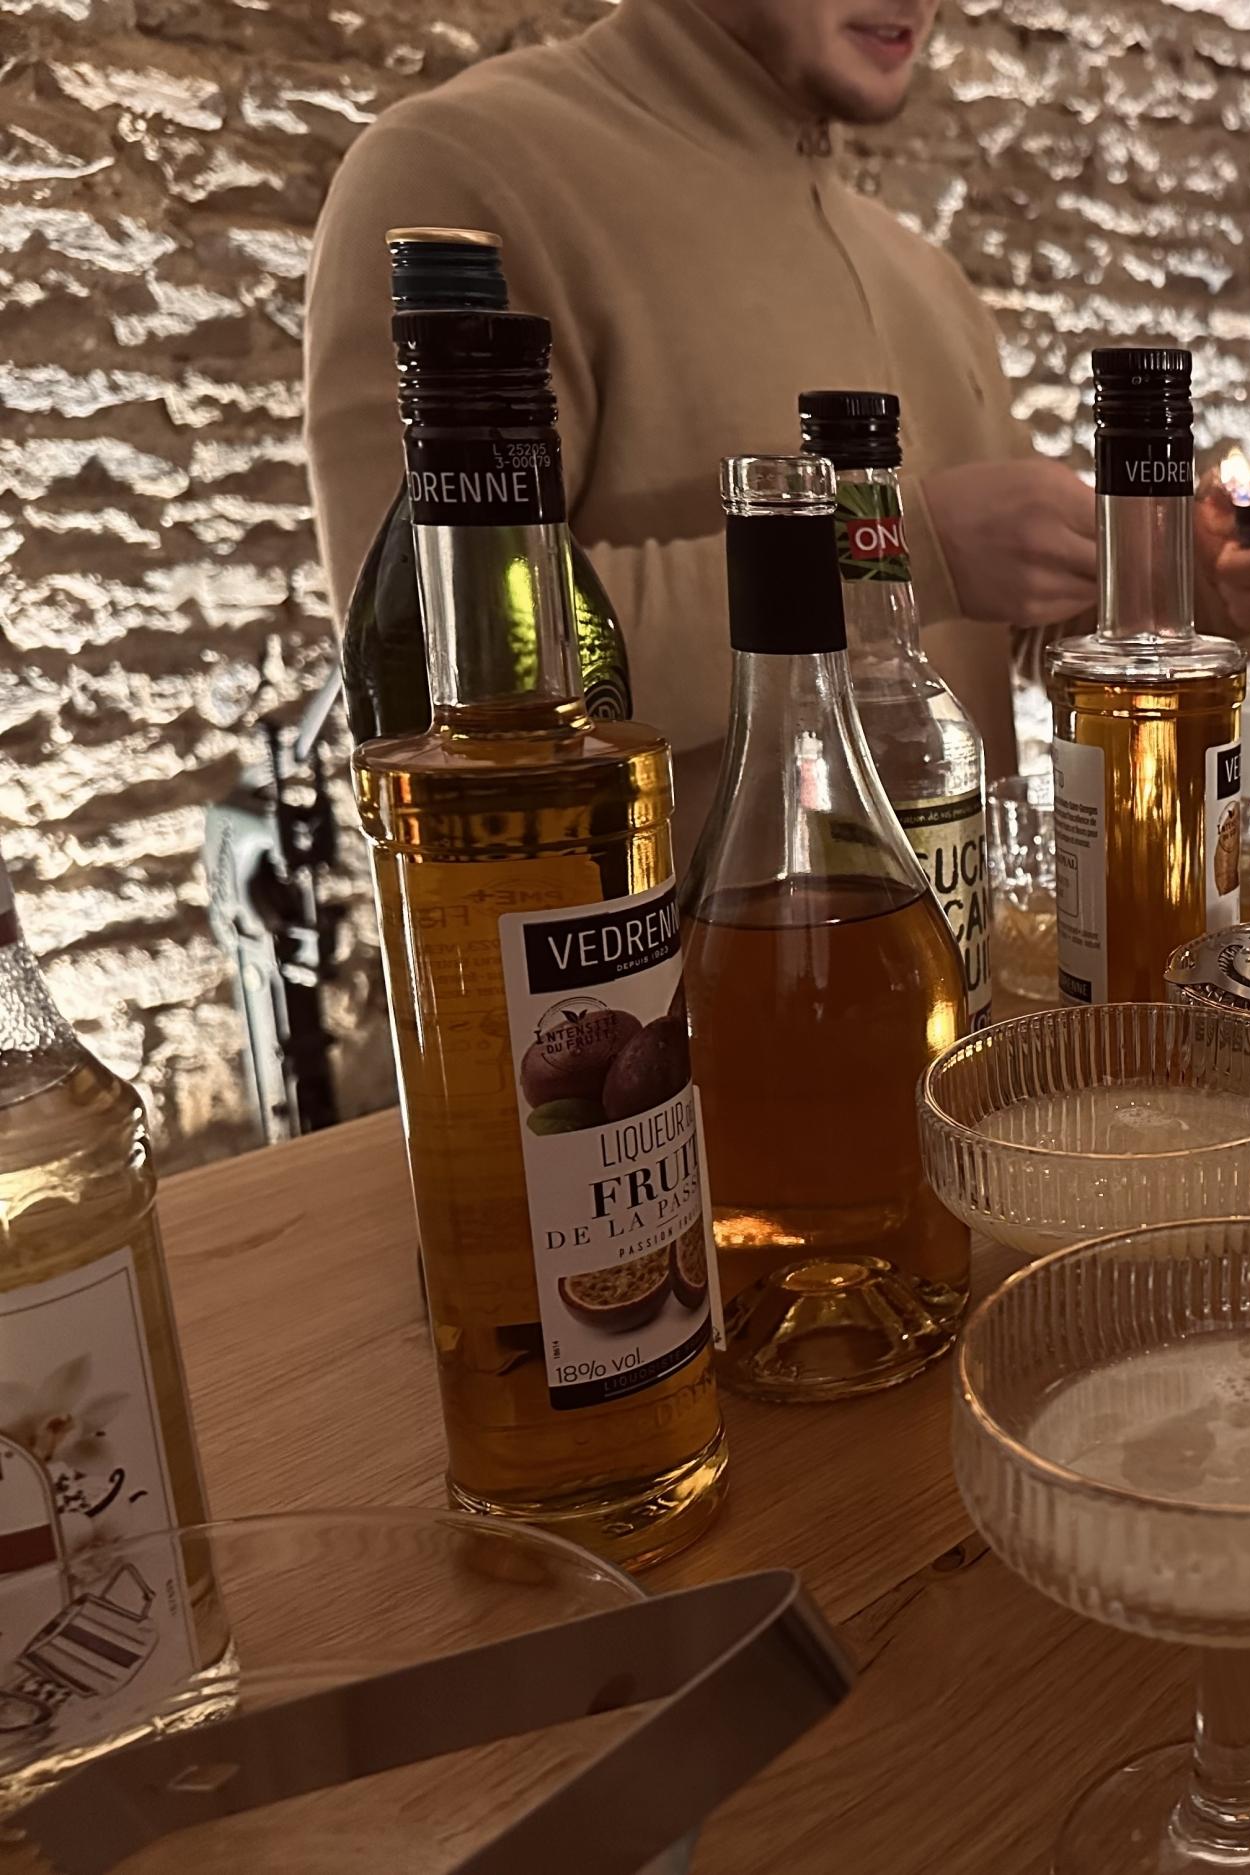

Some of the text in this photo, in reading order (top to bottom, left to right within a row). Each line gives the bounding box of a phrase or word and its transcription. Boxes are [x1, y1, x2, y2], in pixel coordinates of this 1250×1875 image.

[492, 443, 546, 456] L 25205
[616, 955, 648, 971] DEPUIS
[546, 1029, 609, 1054] DU FRUIT
[600, 1102, 684, 1167] LIQUEUR
[546, 1225, 590, 1250] DE
[608, 1213, 645, 1239] LA
[619, 1228, 673, 1258] PASSION
[555, 1360, 607, 1384] 18%
